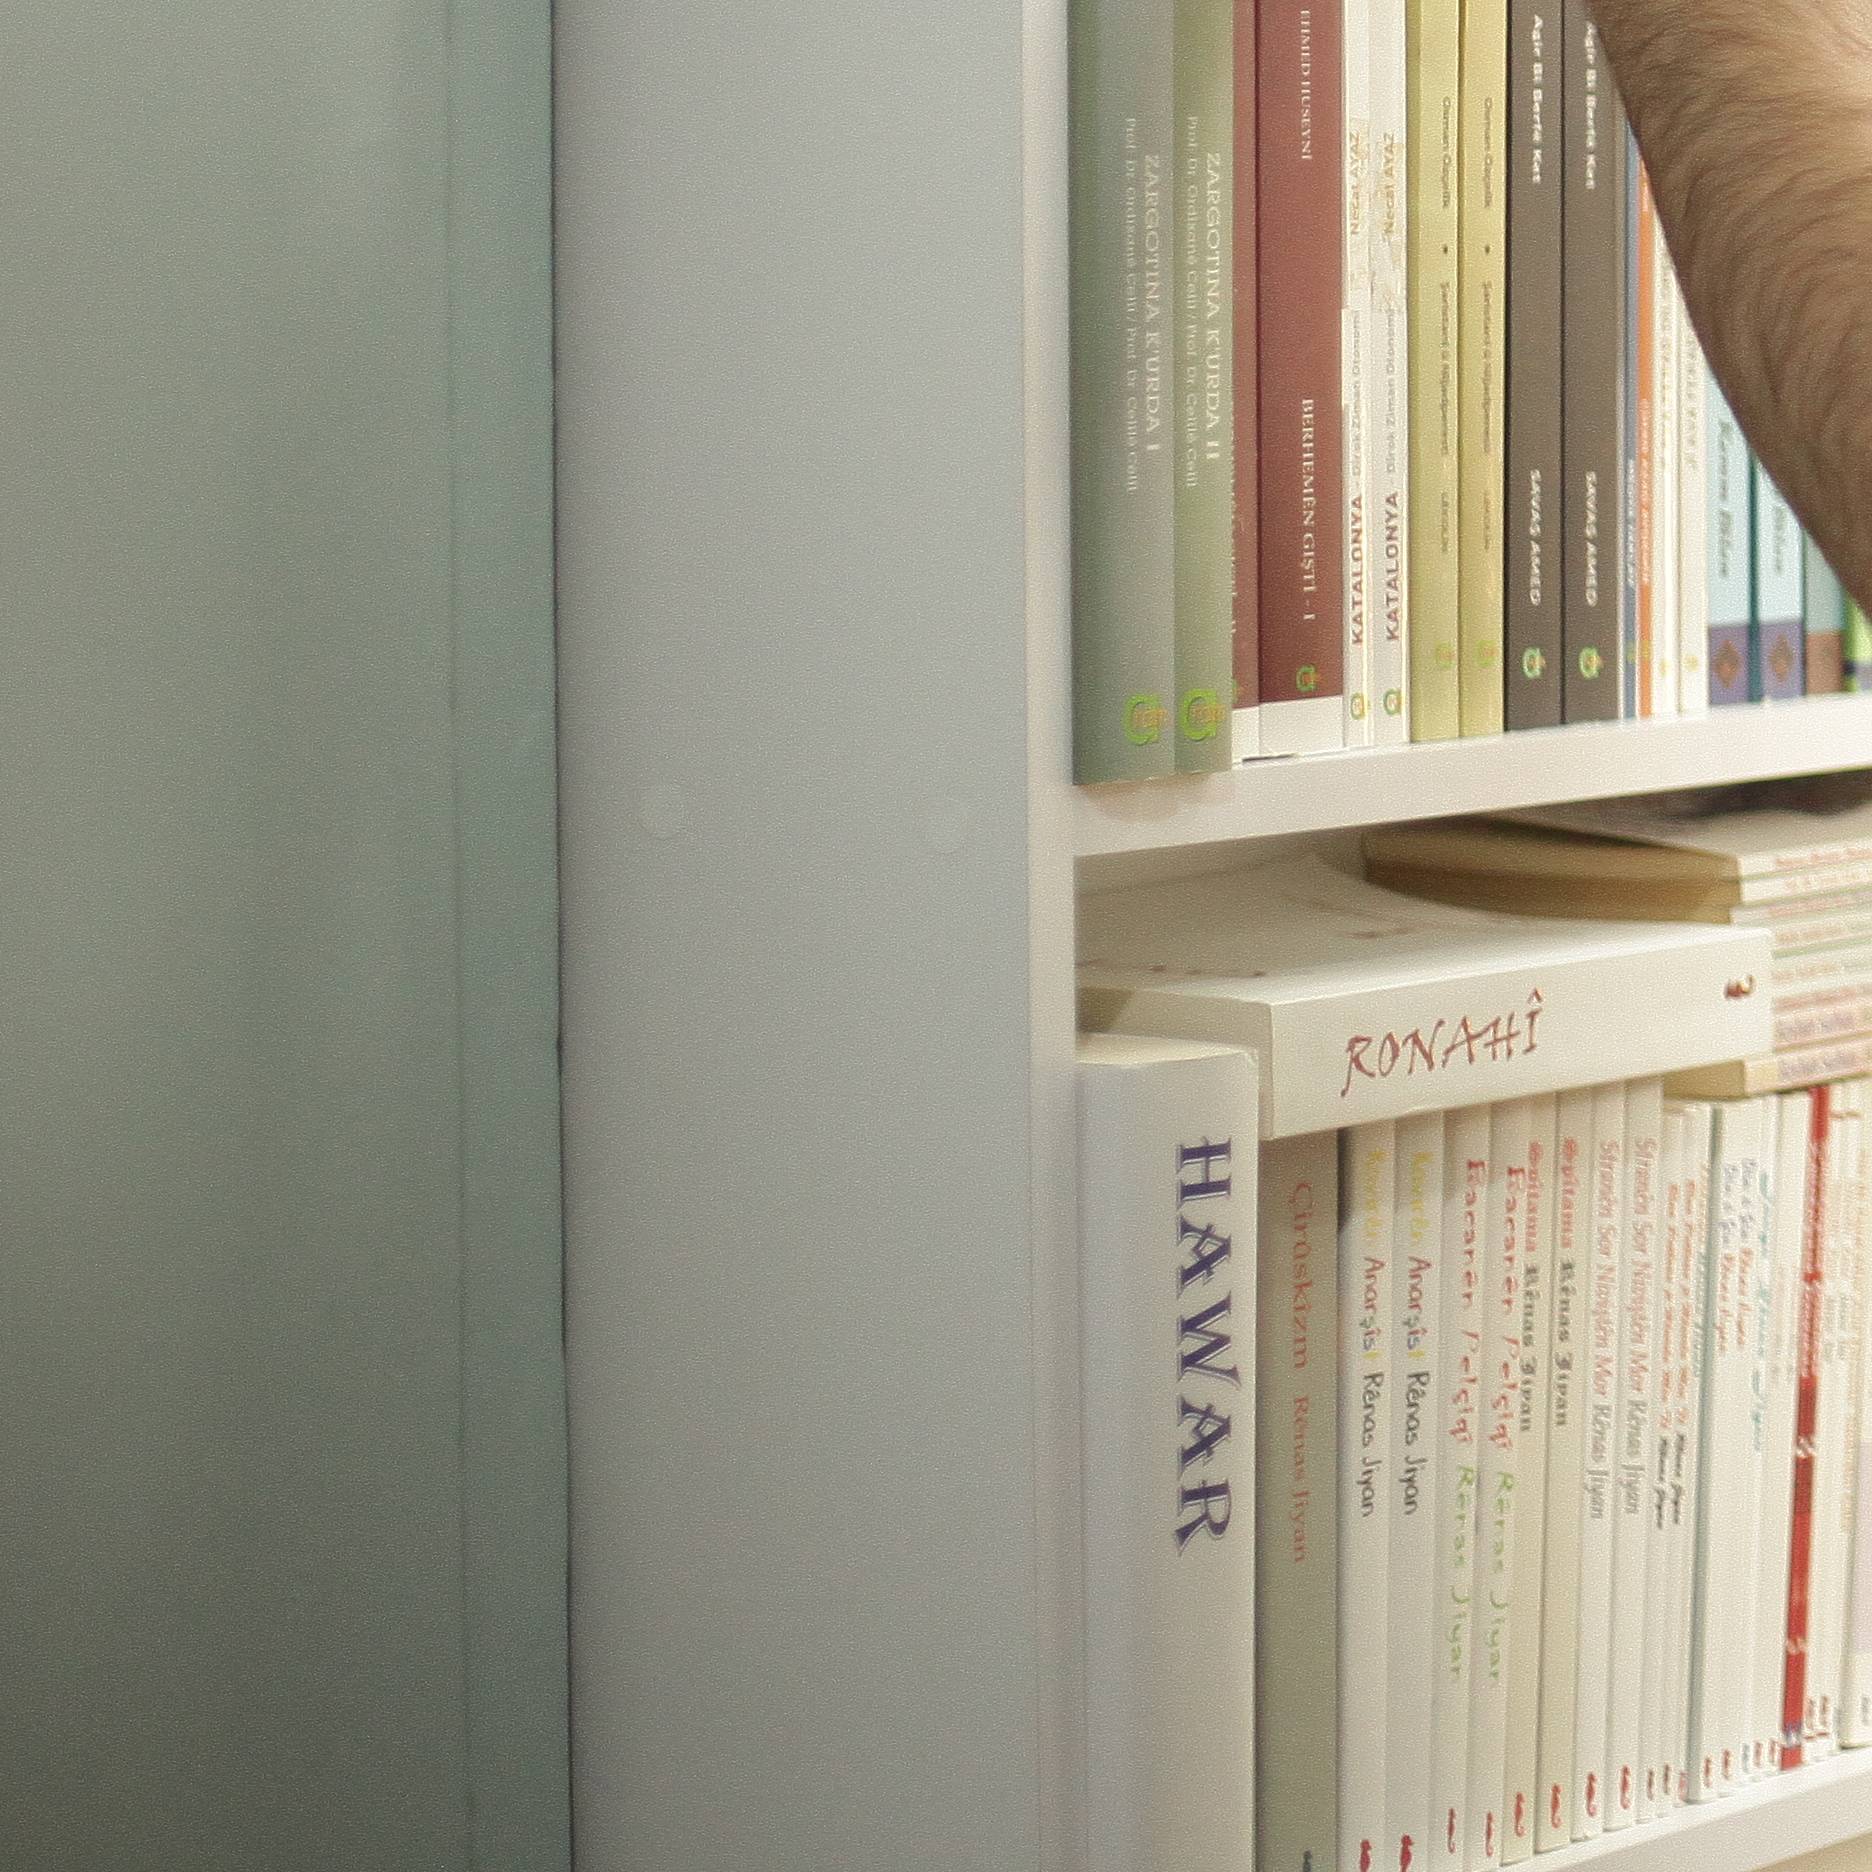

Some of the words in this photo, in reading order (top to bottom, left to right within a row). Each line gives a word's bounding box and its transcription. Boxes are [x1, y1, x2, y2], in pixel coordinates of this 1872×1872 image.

[1299, 9, 1312, 78] EHMED
[1531, 14, 1544, 58] Agir
[1584, 21, 1597, 65] Agir
[1350, 131, 1361, 178] AYAZ
[1384, 131, 1395, 178] AYAZ
[1532, 148, 1543, 184] Ket
[1585, 154, 1597, 190] Ket
[1144, 153, 1161, 323] ZARGOTINA
[1205, 152, 1222, 320] ZARGOTINA
[1144, 330, 1161, 433] K'URDA
[1205, 328, 1222, 431] K'URDA
[1205, 440, 1221, 460] II
[1301, 398, 1317, 526] BERHEMÊN
[1351, 495, 1364, 645] KATALONYA
[1384, 492, 1399, 641] KATALONYA
[1529, 540, 1542, 606] AMED
[1585, 541, 1598, 607] AMED
[1341, 988, 1543, 1096] RONAHÎ
[1595, 1224, 1619, 1259] Sor
[1630, 1220, 1655, 1256] Sor
[1175, 1136, 1240, 1558] HAWAR
[1592, 1353, 1614, 1397] Mor
[1628, 1348, 1651, 1393] Mor
[1293, 1394, 1312, 1482] Rênas
[1361, 1372, 1386, 1448] Rênas
[1404, 1370, 1431, 1446] Rênas
[1591, 1403, 1613, 1465] Rênas
[1626, 1398, 1648, 1460] Rênas
[1356, 1456, 1384, 1518] Jiyan
[1399, 1455, 1428, 1515] Jiyan
[1453, 1464, 1476, 1570] Rênas
[1584, 1469, 1611, 1520] Jiyan
[1620, 1464, 1646, 1516] Jiyan
[1289, 1490, 1312, 1564] Jiyan
[1491, 1471, 1517, 1574] Rênas
[1447, 1587, 1471, 1684] Jiyan
[1485, 1590, 1511, 1684] Jiyan
